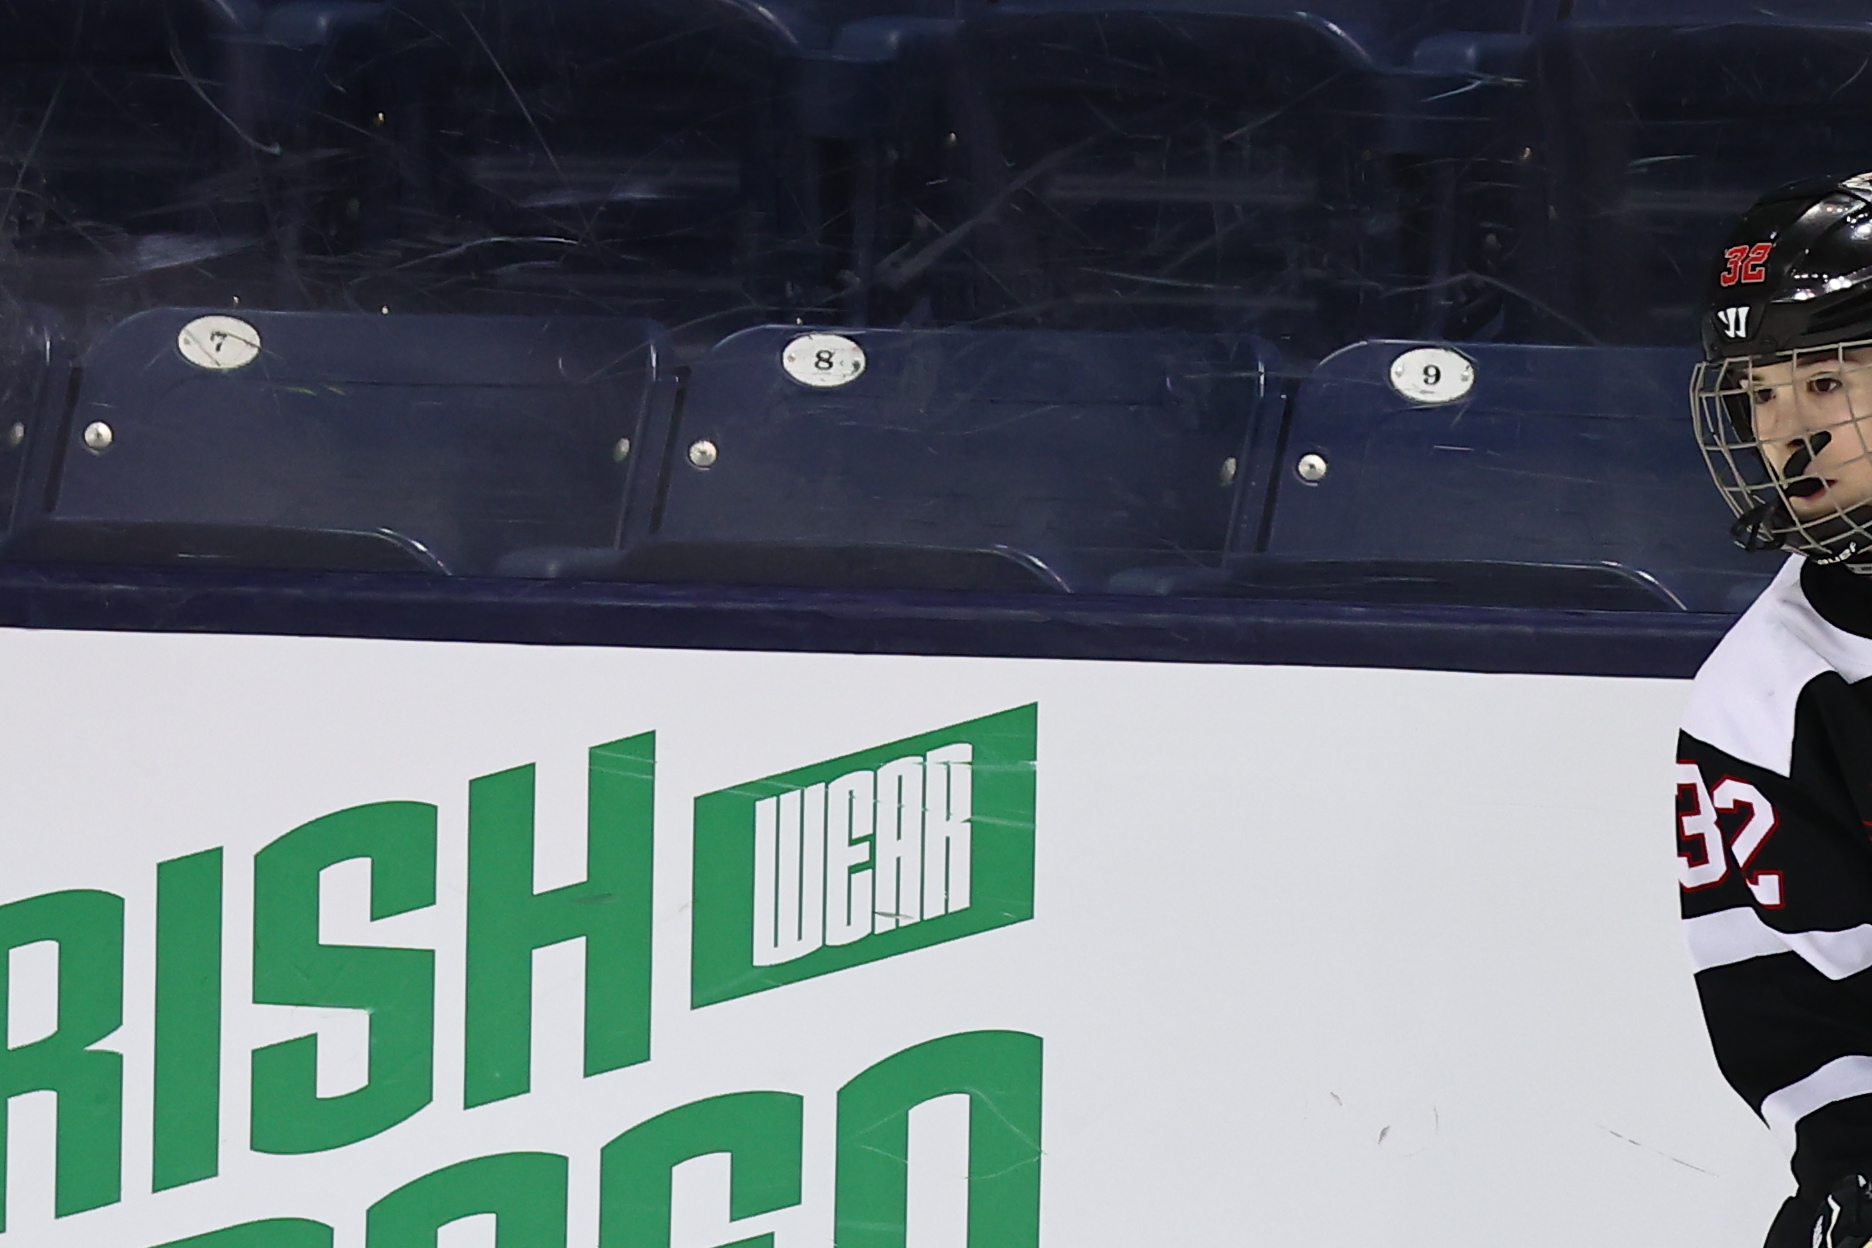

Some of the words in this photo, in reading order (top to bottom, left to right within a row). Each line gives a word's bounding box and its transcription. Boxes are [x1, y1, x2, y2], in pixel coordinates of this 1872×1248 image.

[1720, 242, 1773, 288] 32
[209, 330, 228, 353] 7
[814, 349, 834, 371] 8
[1423, 364, 1442, 386] 9
[1676, 758, 1786, 910] 32
[751, 741, 974, 968] WEAR
